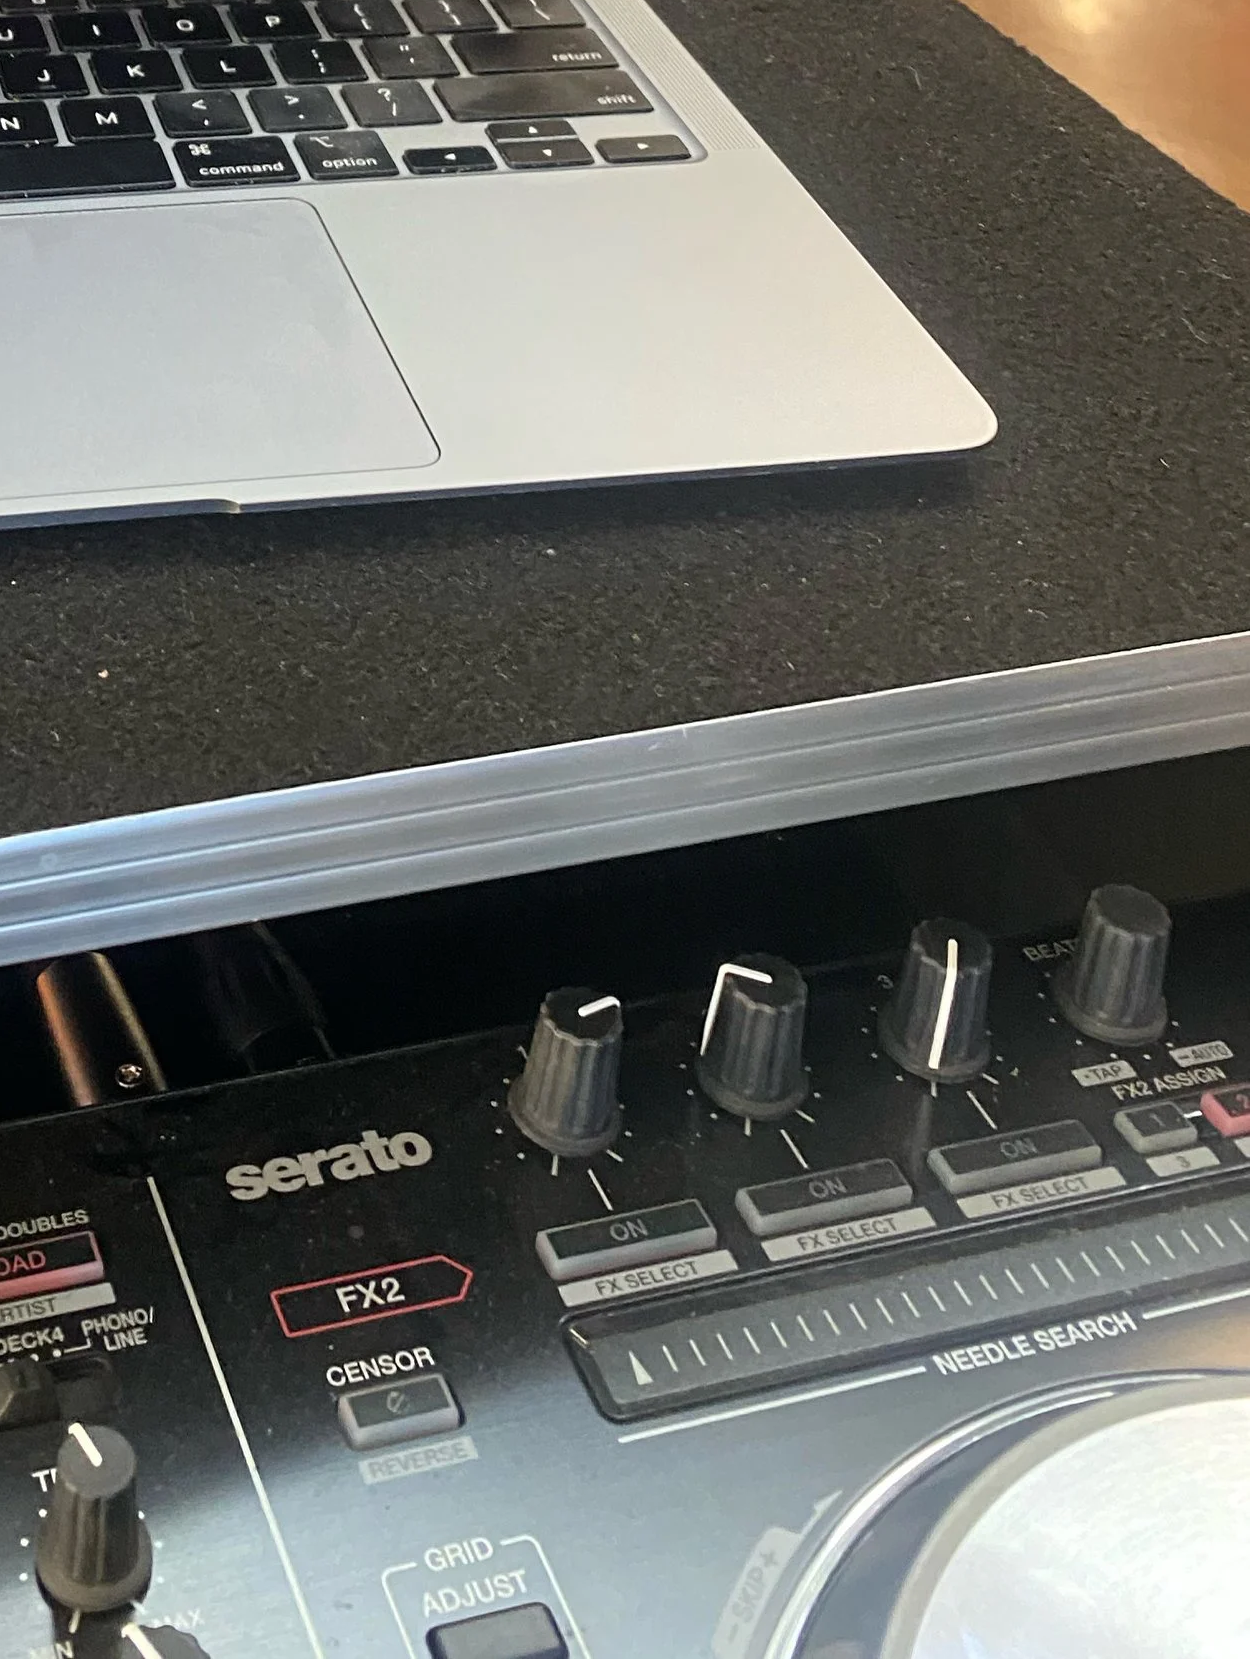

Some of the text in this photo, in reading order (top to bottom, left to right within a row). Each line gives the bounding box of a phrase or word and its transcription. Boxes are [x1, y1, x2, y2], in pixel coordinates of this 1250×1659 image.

[552, 52, 601, 63] return
[597, 94, 636, 105] shift
[199, 161, 283, 176] command
[322, 156, 377, 168] option
[1093, 1064, 1121, 1079] TAP
[1112, 1066, 1226, 1101] FX2 ASSIGN
[1001, 1138, 1038, 1157] ON
[225, 1130, 432, 1200] serato
[809, 1177, 846, 1198] ON
[993, 1176, 1090, 1209] FX SELECT
[610, 1219, 647, 1241] ON
[797, 1218, 897, 1250] FX SELECT
[596, 1261, 698, 1294] FX SELECT
[335, 1278, 405, 1312] FX2
[82, 1306, 154, 1336] PHONO/
[104, 1329, 147, 1351] LINE
[934, 1311, 1138, 1375] NEEDLE SEARCH
[326, 1346, 435, 1386] CENSOR
[370, 1443, 469, 1479] REVERSE
[424, 1538, 493, 1572] GRID
[422, 1570, 527, 1618] ADJUST
